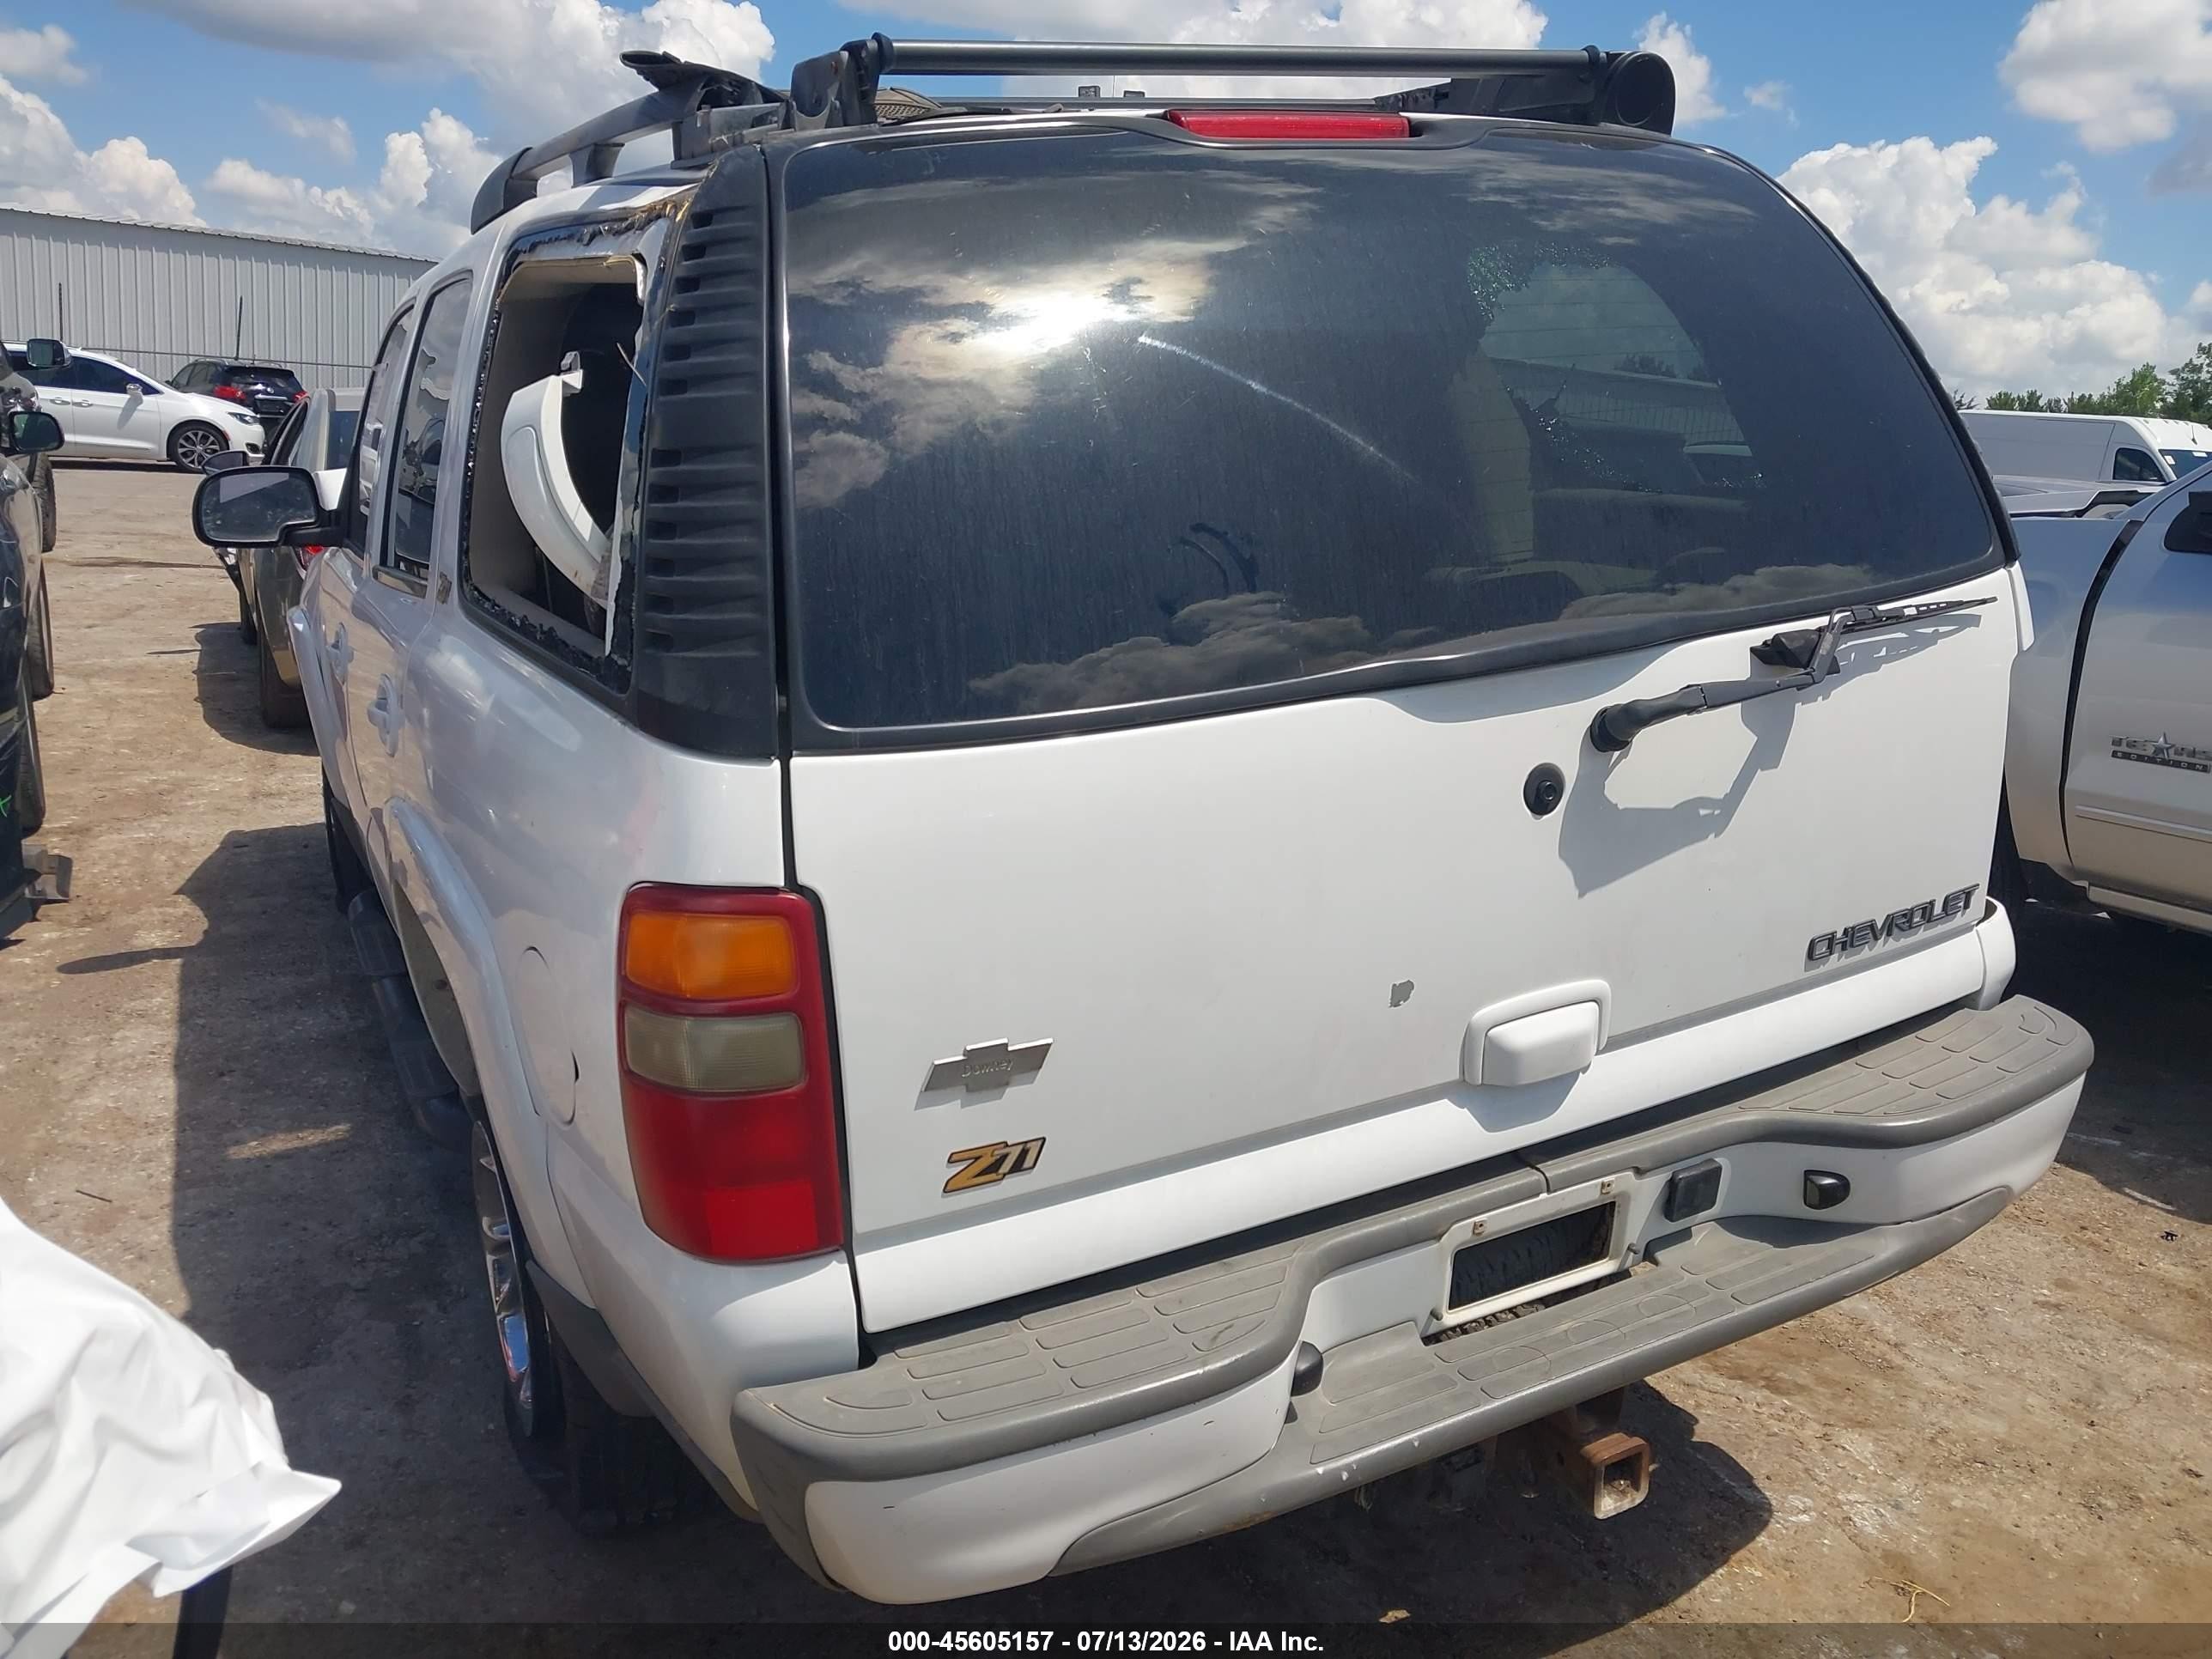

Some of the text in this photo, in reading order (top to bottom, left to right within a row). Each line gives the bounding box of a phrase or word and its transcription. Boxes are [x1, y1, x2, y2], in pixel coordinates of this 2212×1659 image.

[2116, 750, 2203, 771] EDITION
[1808, 883, 1980, 961] CHEVROLET
[943, 1136, 1046, 1194] Z71
